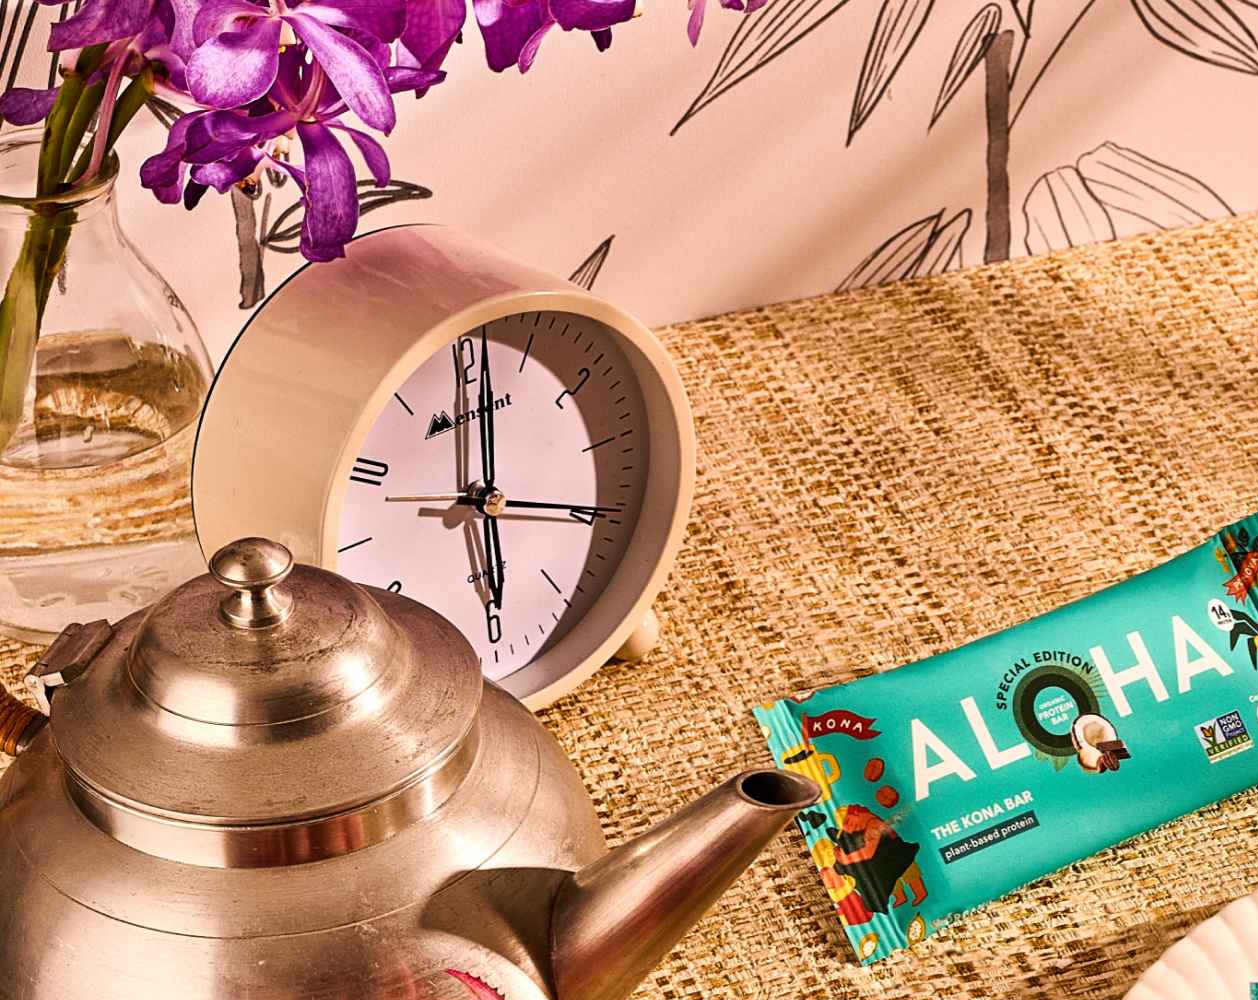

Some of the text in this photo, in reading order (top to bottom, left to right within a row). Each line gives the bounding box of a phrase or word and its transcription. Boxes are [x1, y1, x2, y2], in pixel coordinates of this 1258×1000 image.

[453, 337, 477, 388] 12
[555, 367, 590, 409] 2
[425, 393, 512, 440] Mensnt
[350, 457, 389, 486] 10
[467, 560, 507, 584] QUAZ
[486, 600, 501, 643] 6
[996, 650, 1094, 710] SPECIAL EDITION
[812, 718, 863, 733] KONA
[911, 615, 1234, 803] ALOHA
[1219, 712, 1239, 726] NON
[1223, 720, 1242, 733] GMO
[930, 790, 1034, 840] THE KONA BAR
[945, 816, 1034, 861] plant-based protein
